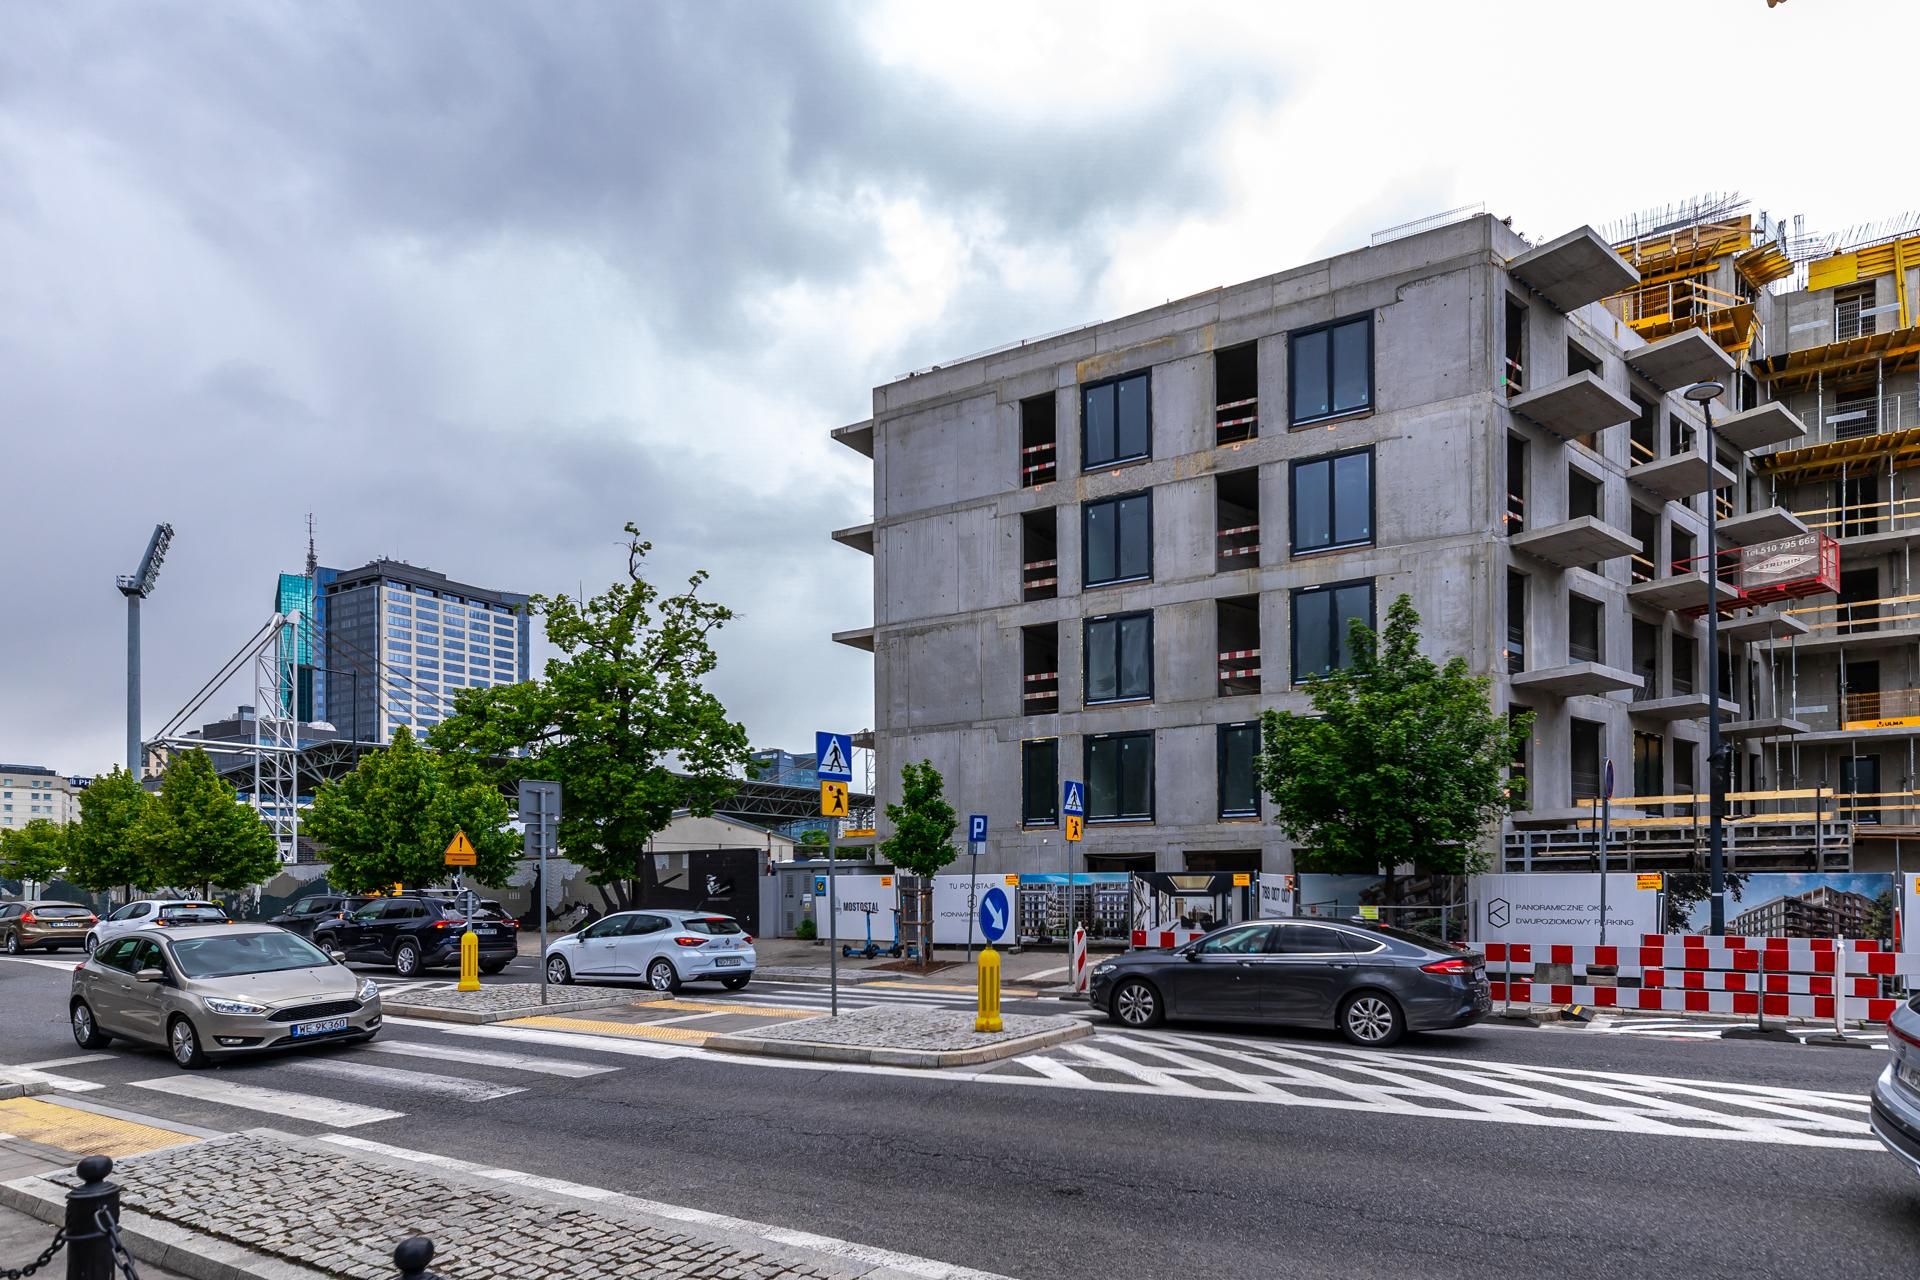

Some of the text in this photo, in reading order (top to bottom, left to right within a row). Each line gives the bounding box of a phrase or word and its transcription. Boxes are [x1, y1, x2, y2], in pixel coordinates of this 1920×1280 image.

[1779, 541, 1797, 550] 795
[1798, 536, 1816, 546] 665
[973, 817, 985, 839] P
[843, 901, 880, 912] MOSTOSTAL
[1515, 904, 1614, 912] PANORAMICZNE OKA
[1515, 917, 1635, 927] DWUPOZIOMOWY PRKING
[299, 1024, 311, 1033] WE
